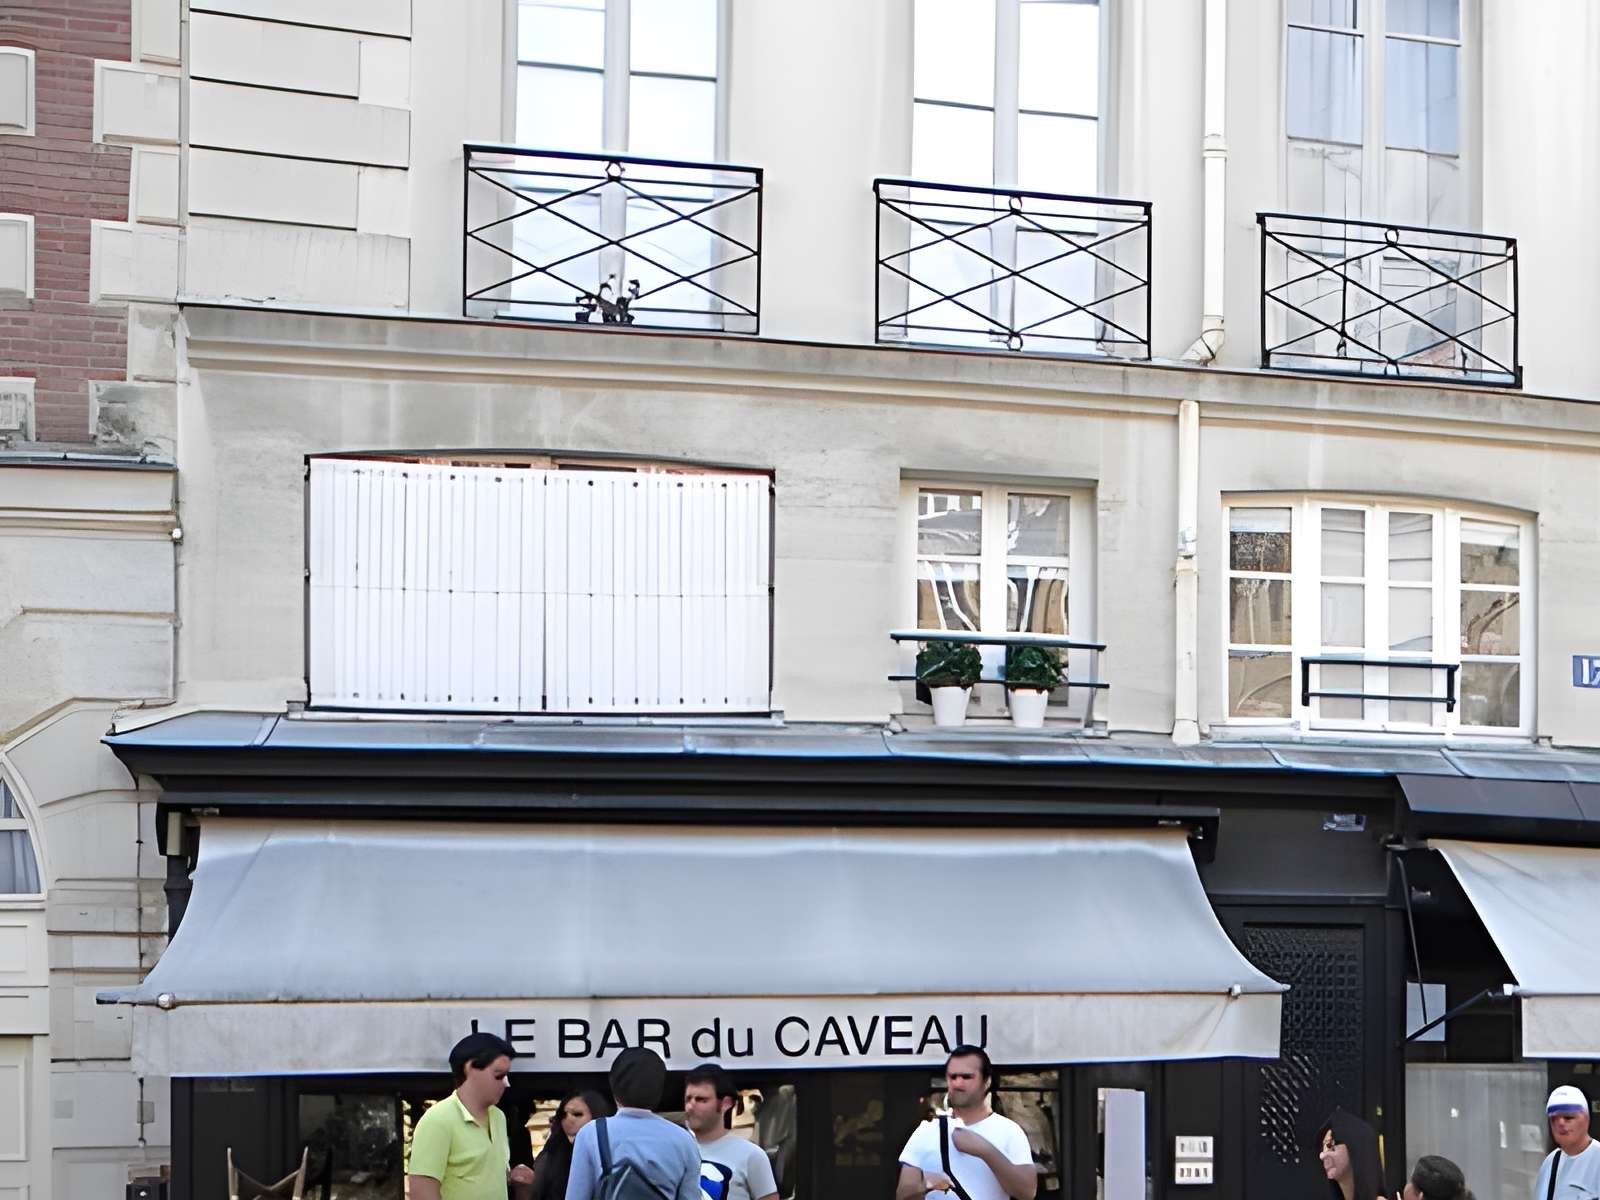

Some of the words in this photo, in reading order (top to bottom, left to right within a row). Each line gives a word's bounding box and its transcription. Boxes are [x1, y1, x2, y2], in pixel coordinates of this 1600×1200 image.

[558, 1018, 671, 1059] BAR
[691, 1016, 754, 1059] du
[775, 1014, 988, 1058] CAVEAU
